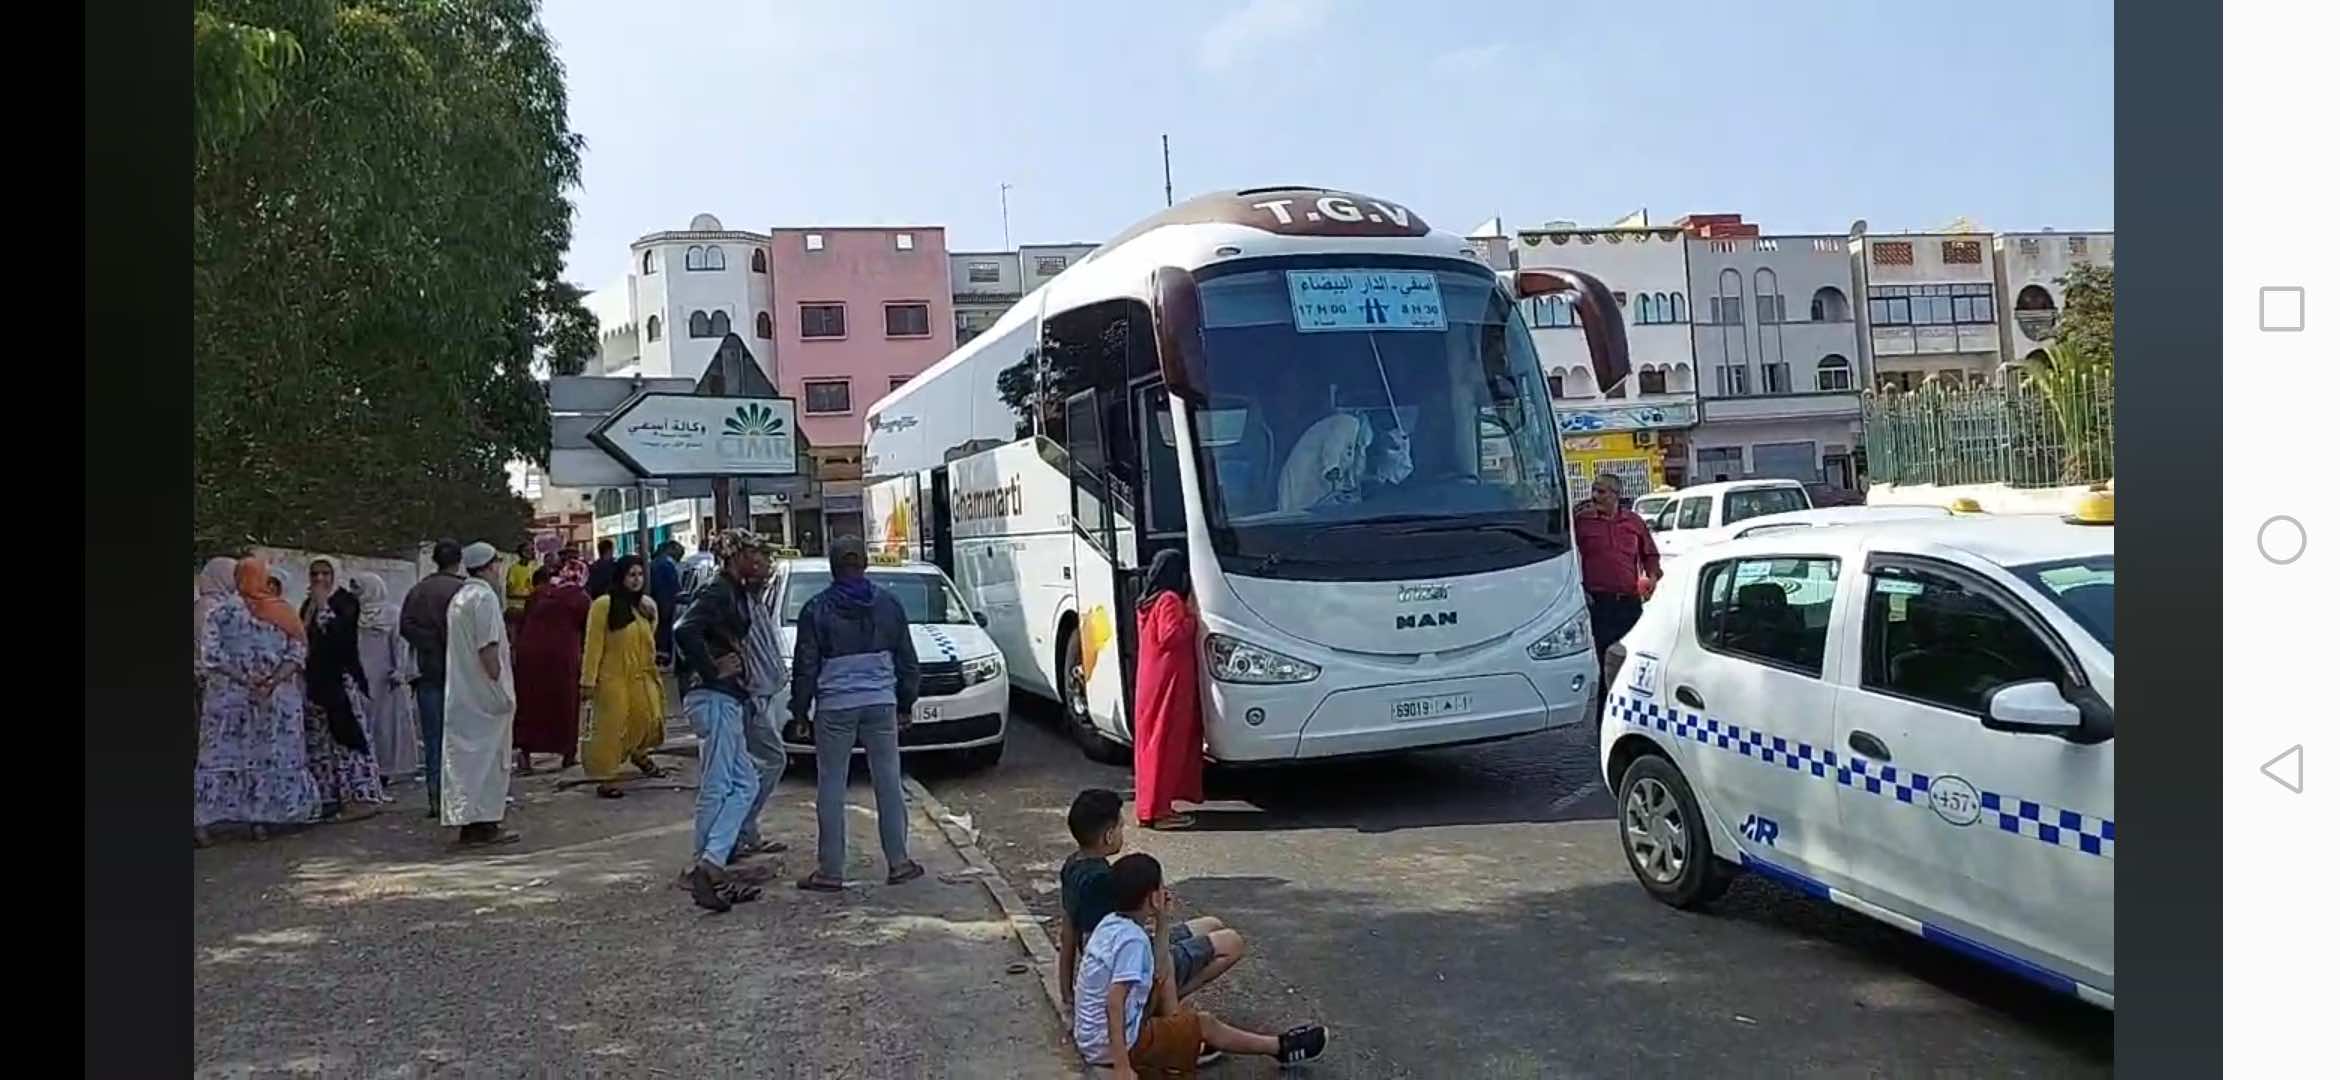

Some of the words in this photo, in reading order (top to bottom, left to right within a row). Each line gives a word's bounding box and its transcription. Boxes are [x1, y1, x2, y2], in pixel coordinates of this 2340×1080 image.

[1253, 197, 1409, 227] T.G.V
[1299, 304, 1312, 315] 17
[1317, 304, 1327, 315] H
[1396, 611, 1458, 630] MAN
[923, 707, 938, 720] 54
[1396, 701, 1429, 718] 69019
